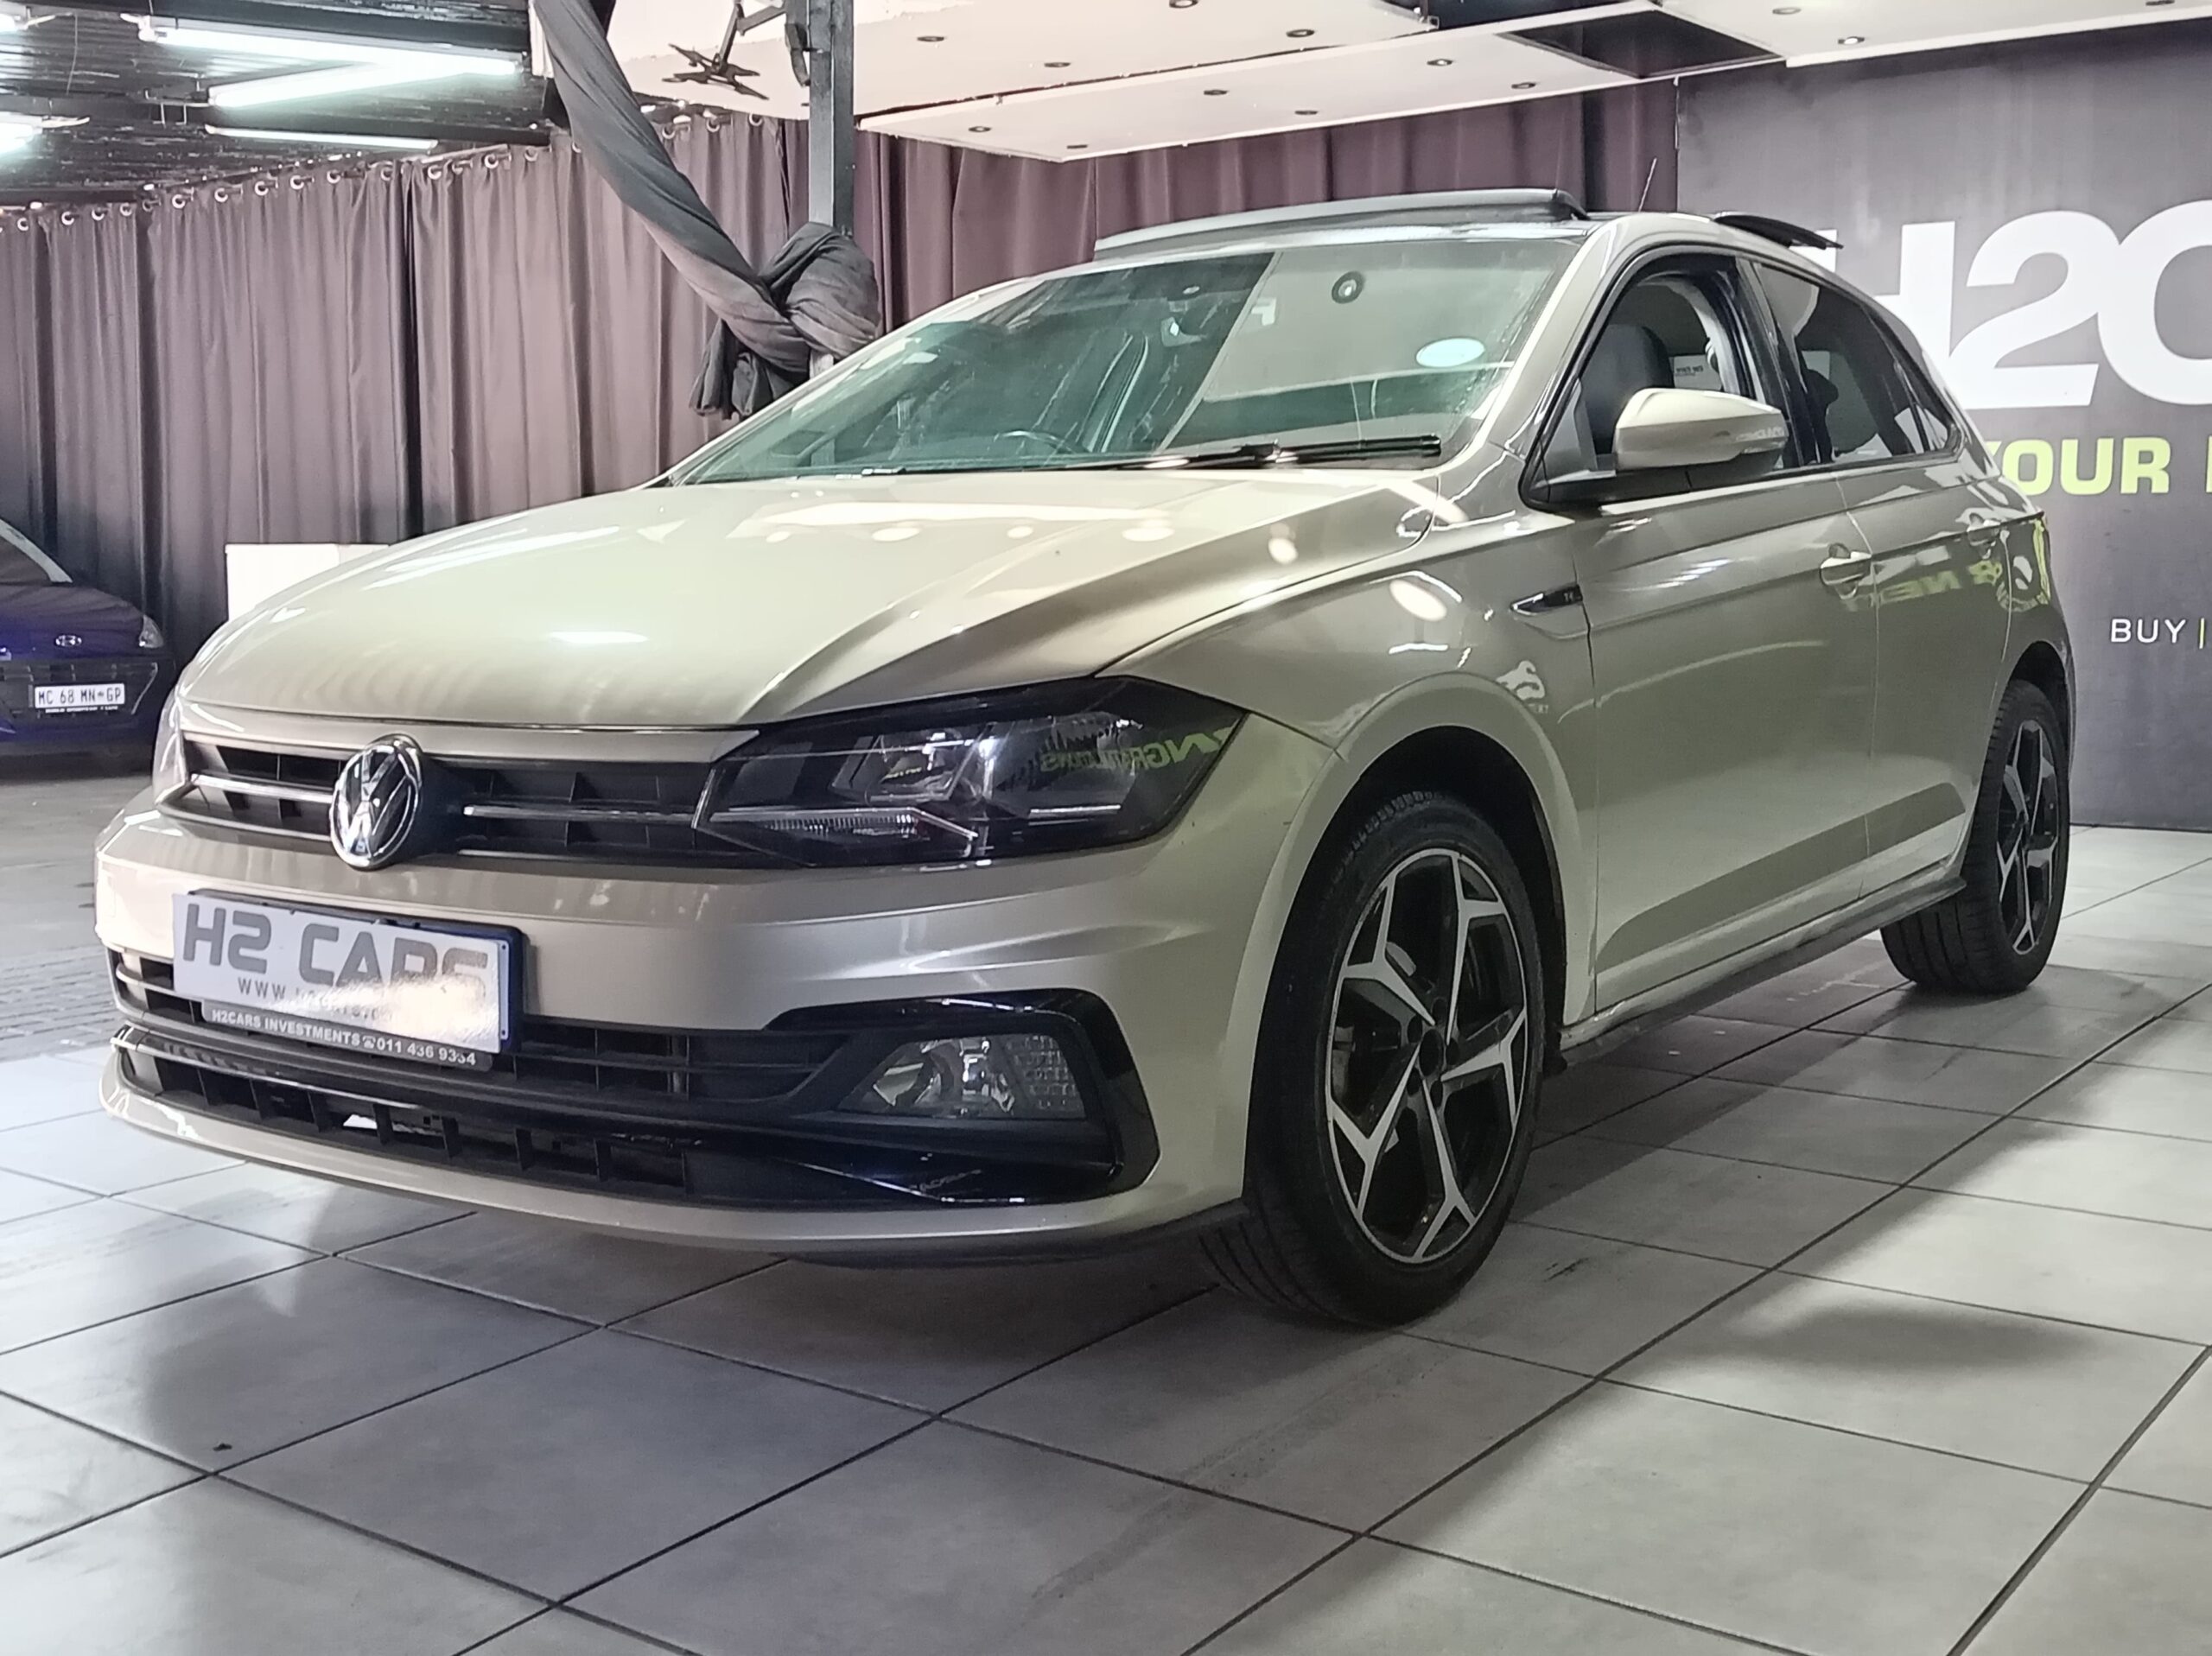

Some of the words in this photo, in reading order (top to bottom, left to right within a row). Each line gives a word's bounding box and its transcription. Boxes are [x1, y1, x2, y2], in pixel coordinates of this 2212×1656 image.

[2111, 619, 2186, 644] BUY
[60, 689, 75, 704] 68
[106, 687, 121, 701] GP
[183, 904, 271, 974] H2
[212, 1009, 261, 1028] H2CARS
[264, 1017, 360, 1047] INVESTMENTS
